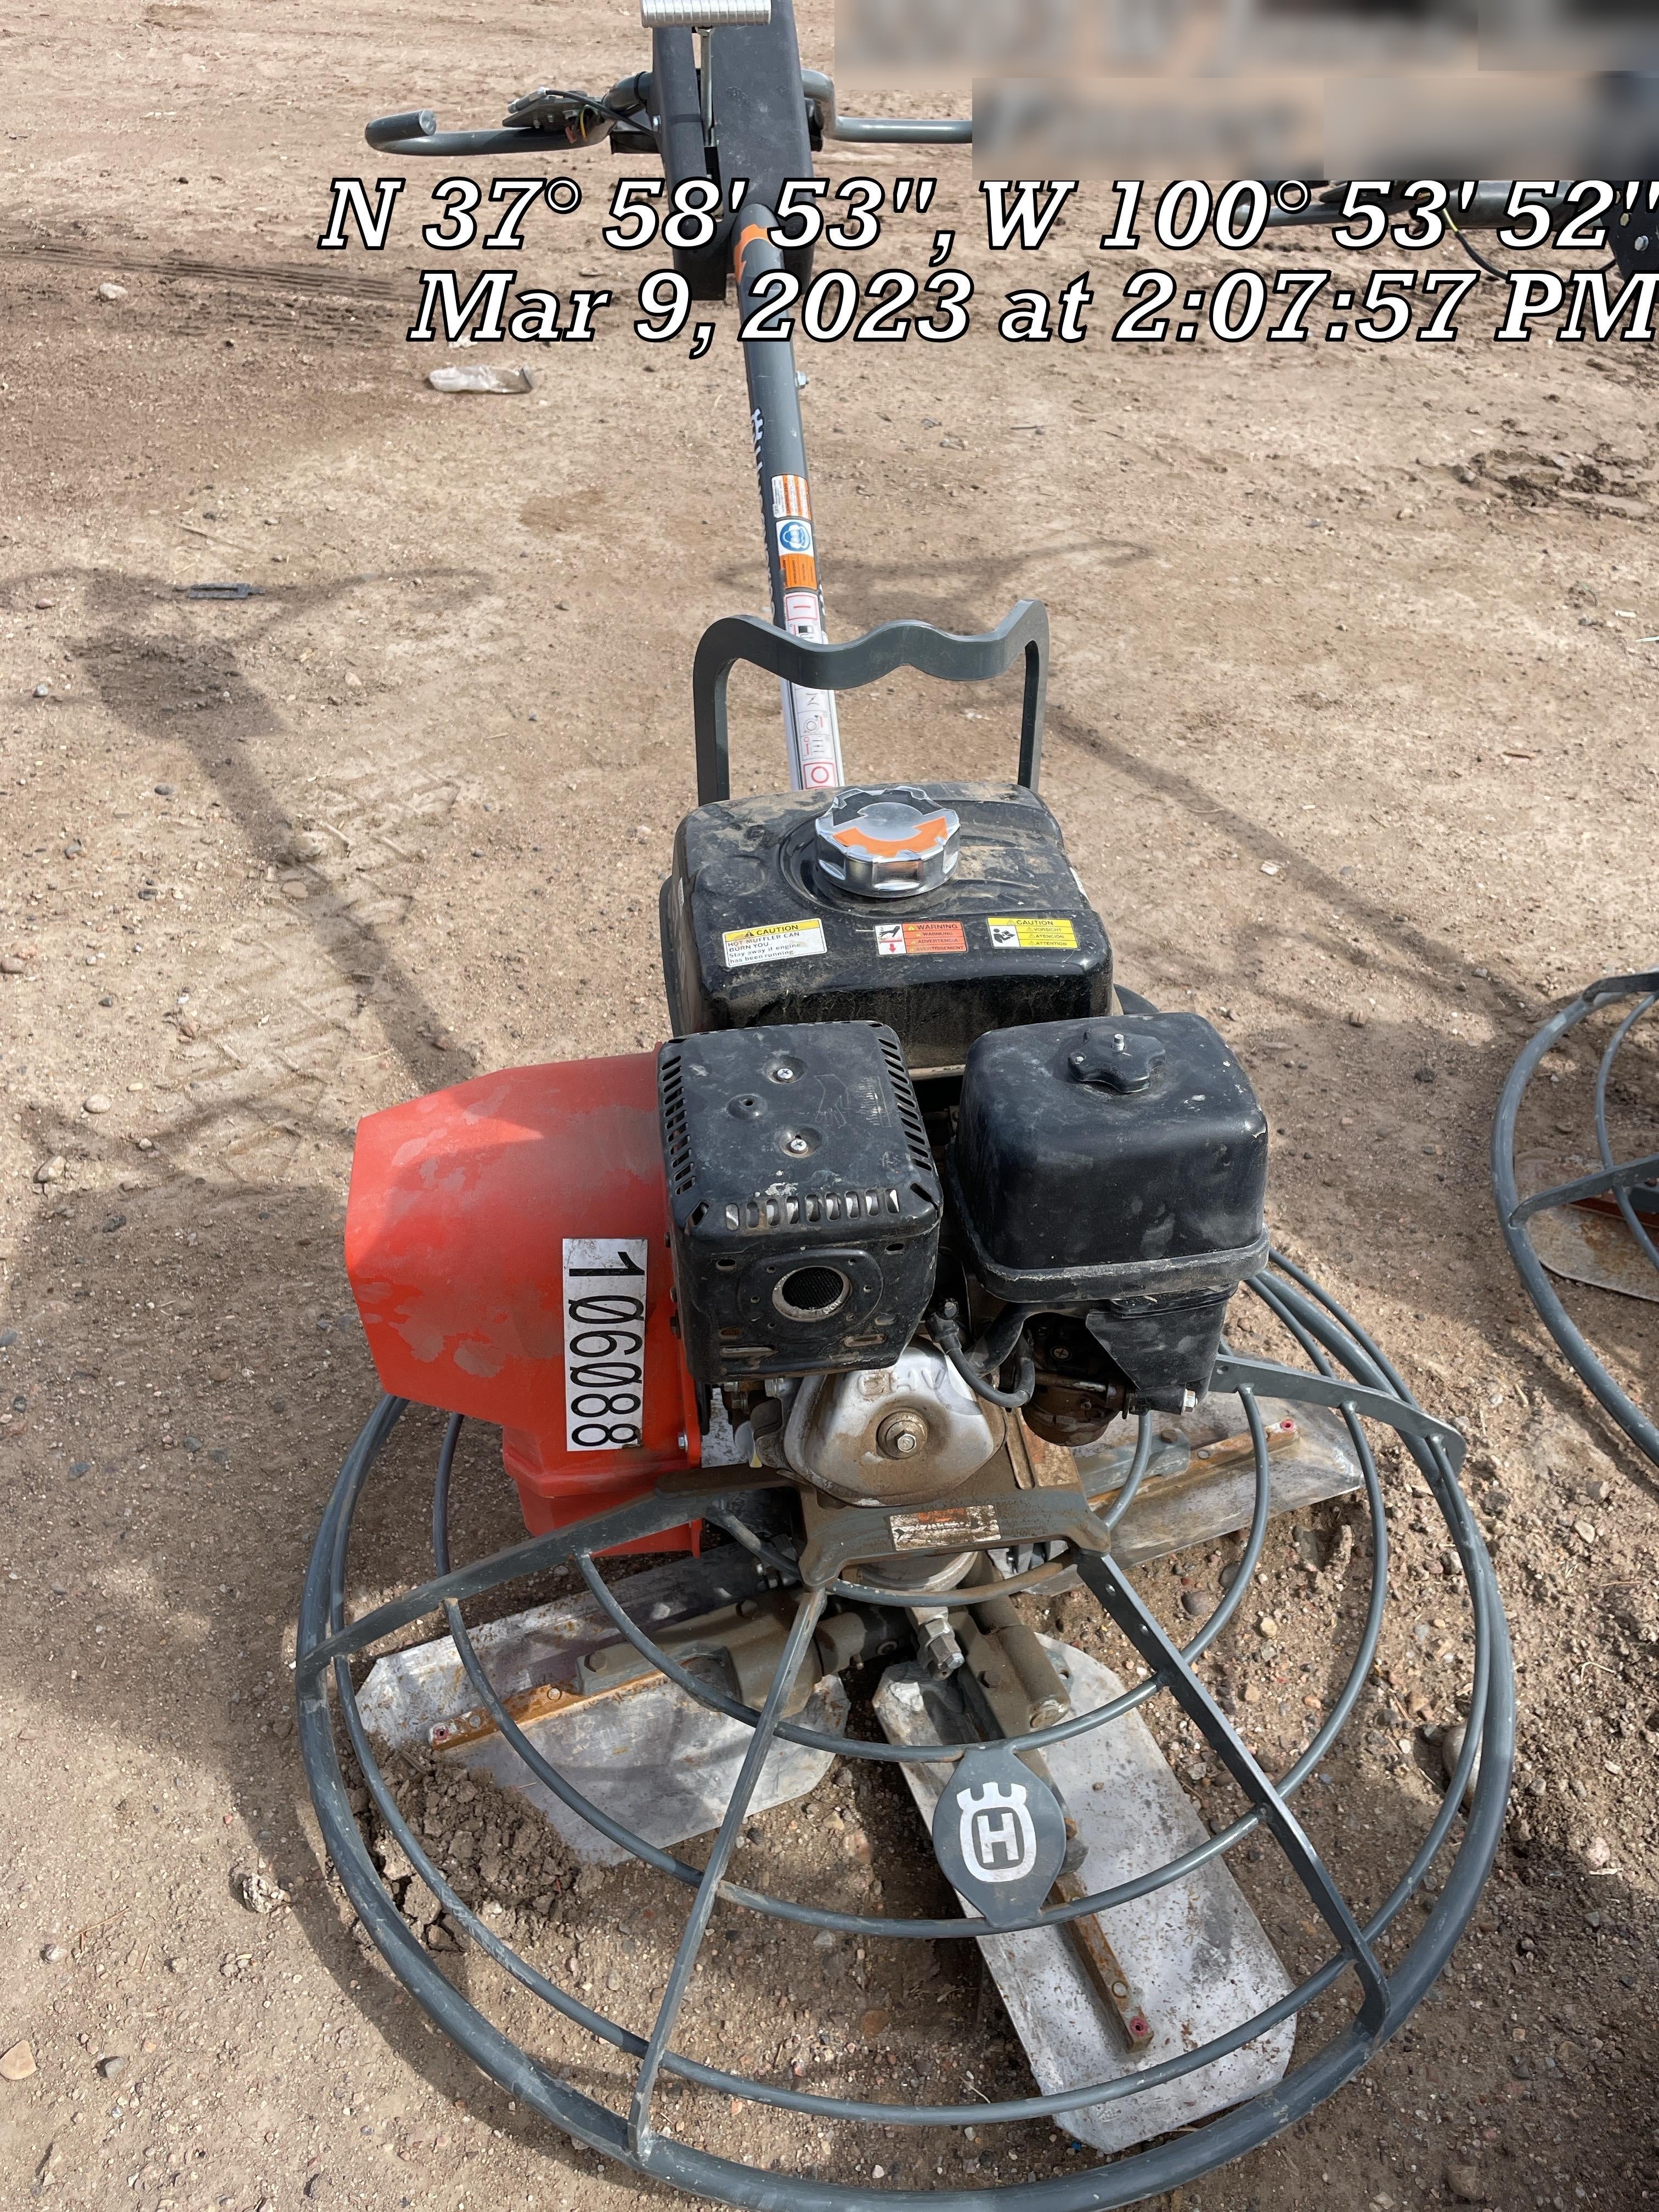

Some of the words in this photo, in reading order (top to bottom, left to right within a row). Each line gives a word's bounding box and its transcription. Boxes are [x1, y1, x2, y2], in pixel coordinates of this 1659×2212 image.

[757, 924, 799, 935] CAUTION
[746, 934, 782, 944] MUFFLER
[568, 1251, 645, 1447] 106088
